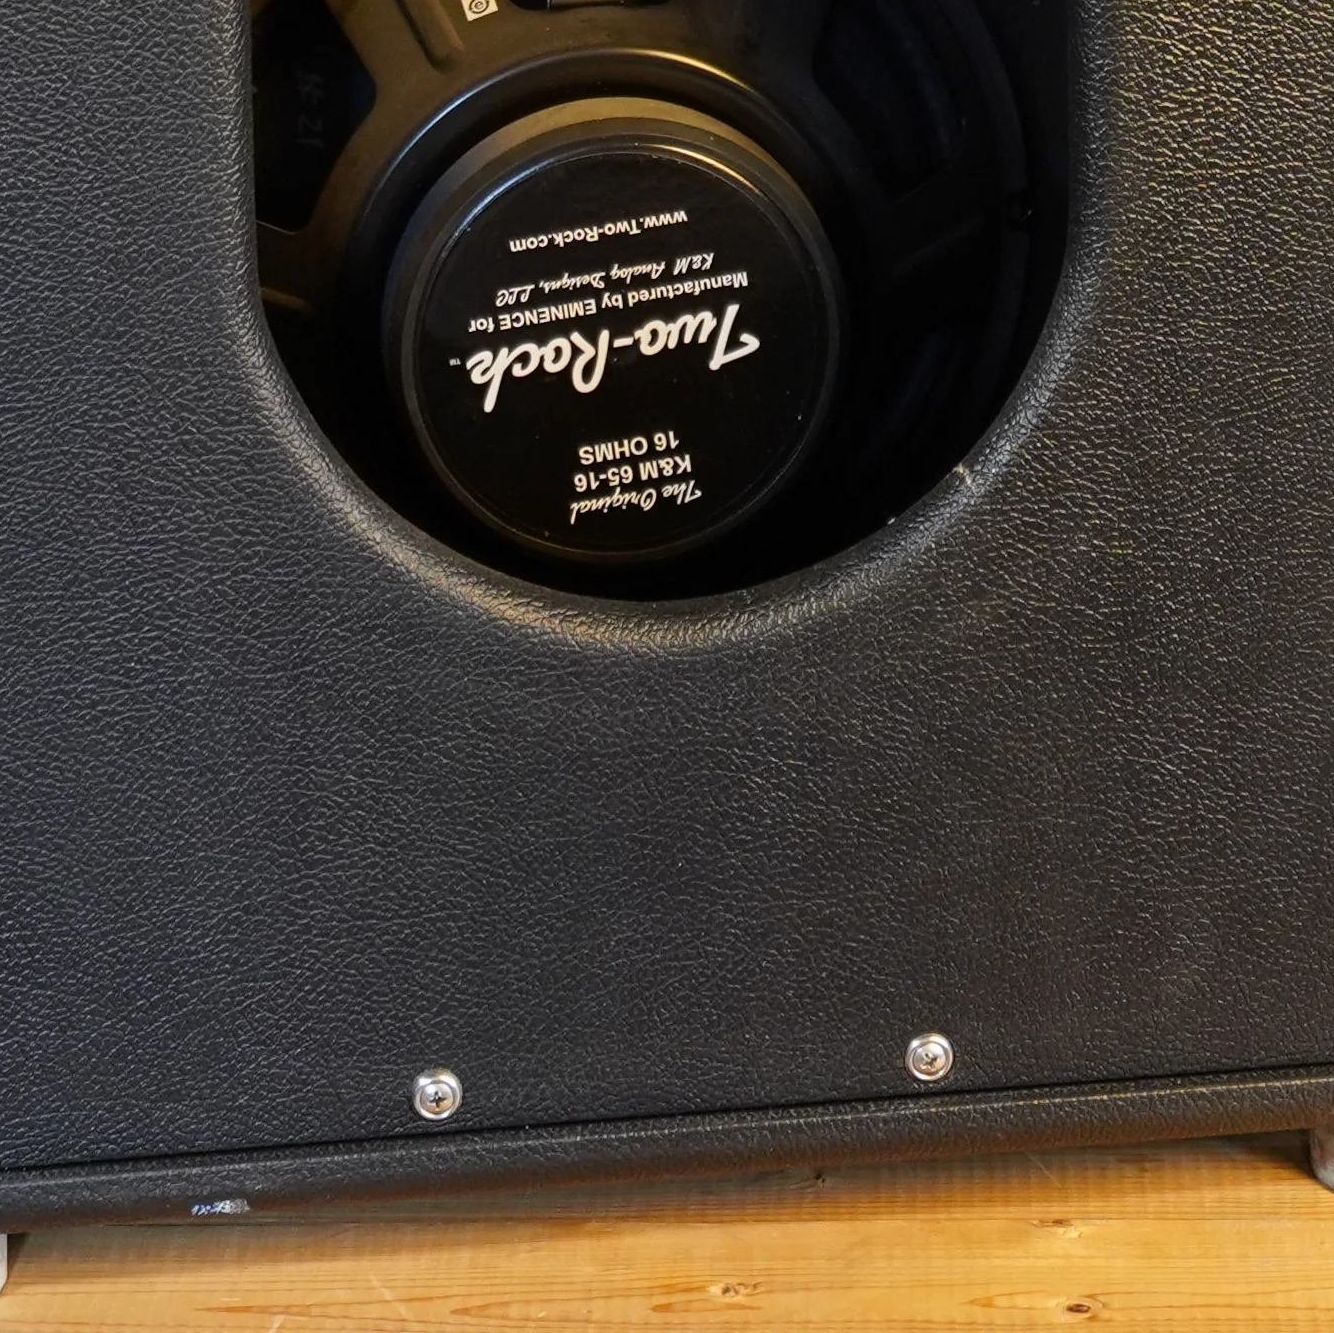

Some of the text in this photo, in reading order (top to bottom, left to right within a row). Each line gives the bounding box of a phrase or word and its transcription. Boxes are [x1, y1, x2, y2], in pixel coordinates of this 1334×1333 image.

[509, 210, 687, 255] www.Two-Rock.com
[538, 268, 605, 296] Designs,
[609, 259, 666, 286] Analog
[675, 252, 714, 275] K&M
[469, 271, 748, 335] Manufactured by EMINENCE for
[465, 303, 760, 413] Two-Rock
[579, 430, 680, 465] 16 OHMS
[573, 454, 692, 492] K&M 65-16
[570, 479, 702, 524] The Original
